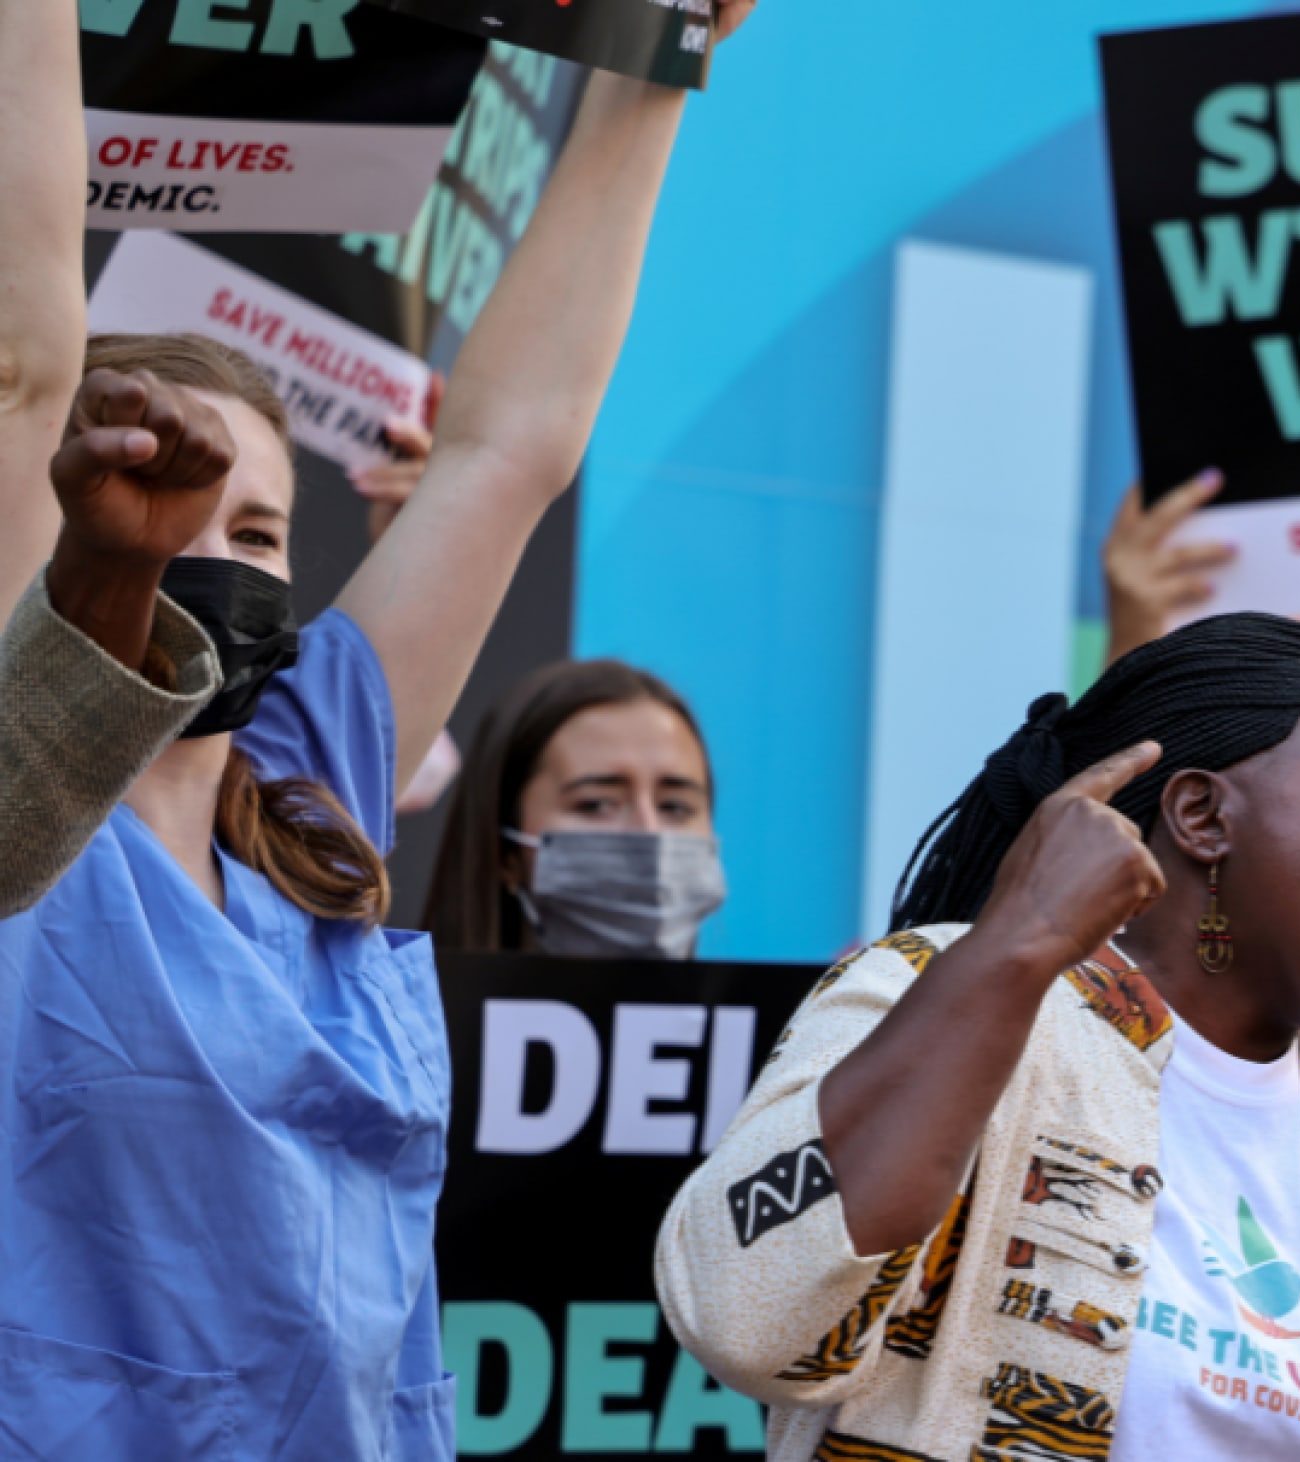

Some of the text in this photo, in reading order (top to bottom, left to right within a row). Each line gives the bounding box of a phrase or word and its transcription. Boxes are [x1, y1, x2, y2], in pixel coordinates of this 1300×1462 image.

[99, 135, 294, 173] OF LIVES.
[207, 287, 286, 348] SAVE
[284, 328, 414, 415] MILLIONS
[286, 377, 335, 428] THE
[1208, 1327, 1283, 1382] THE
[1200, 1366, 1248, 1402] FOR
